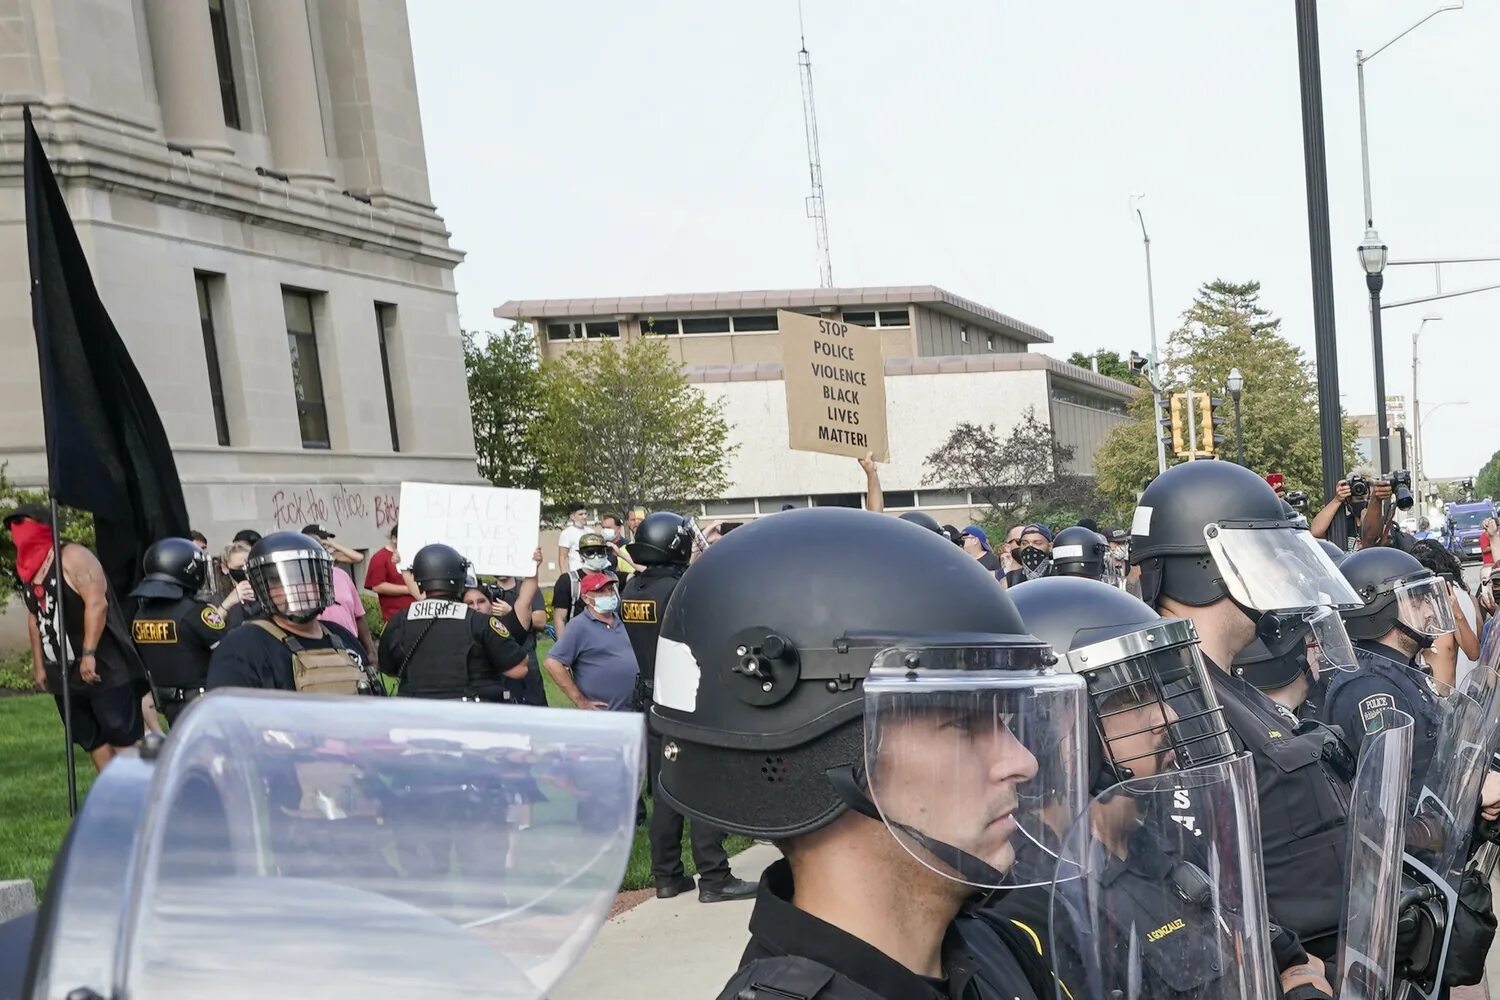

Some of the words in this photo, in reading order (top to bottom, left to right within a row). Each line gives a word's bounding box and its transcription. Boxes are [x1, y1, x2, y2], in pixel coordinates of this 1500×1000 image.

[818, 320, 848, 338] STOP
[813, 340, 855, 361] POLICE
[811, 362, 867, 386] VIOLENCE
[822, 385, 860, 405] BLACK
[827, 406, 860, 425] LIVES
[818, 426, 868, 447] MATTER!
[424, 490, 523, 522] BLACK
[444, 521, 520, 541] LIVES
[413, 601, 462, 617] SHERIFF
[623, 603, 651, 621] SHERIFF
[135, 622, 170, 641] SHERIFF
[1366, 697, 1388, 711] POLICE
